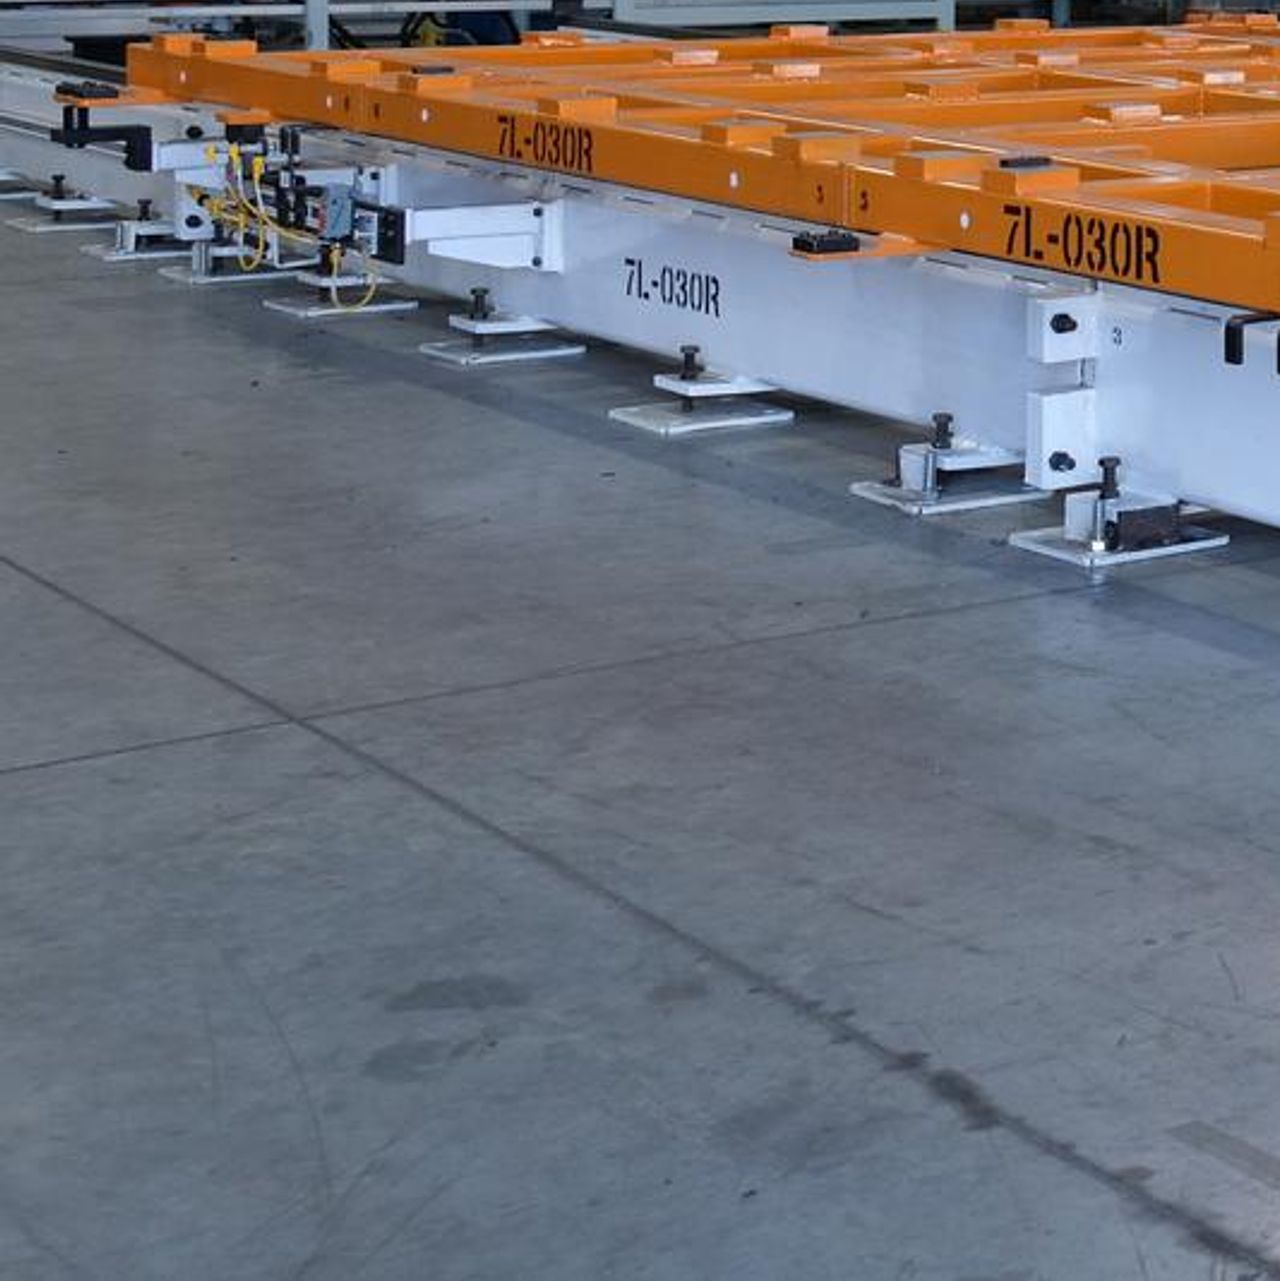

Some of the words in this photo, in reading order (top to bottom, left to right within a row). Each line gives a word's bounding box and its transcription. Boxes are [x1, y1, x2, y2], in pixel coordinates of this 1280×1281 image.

[497, 114, 593, 174] 7L-030R
[1002, 204, 1161, 284] 7L-030R
[624, 257, 720, 318] 7L-030R
